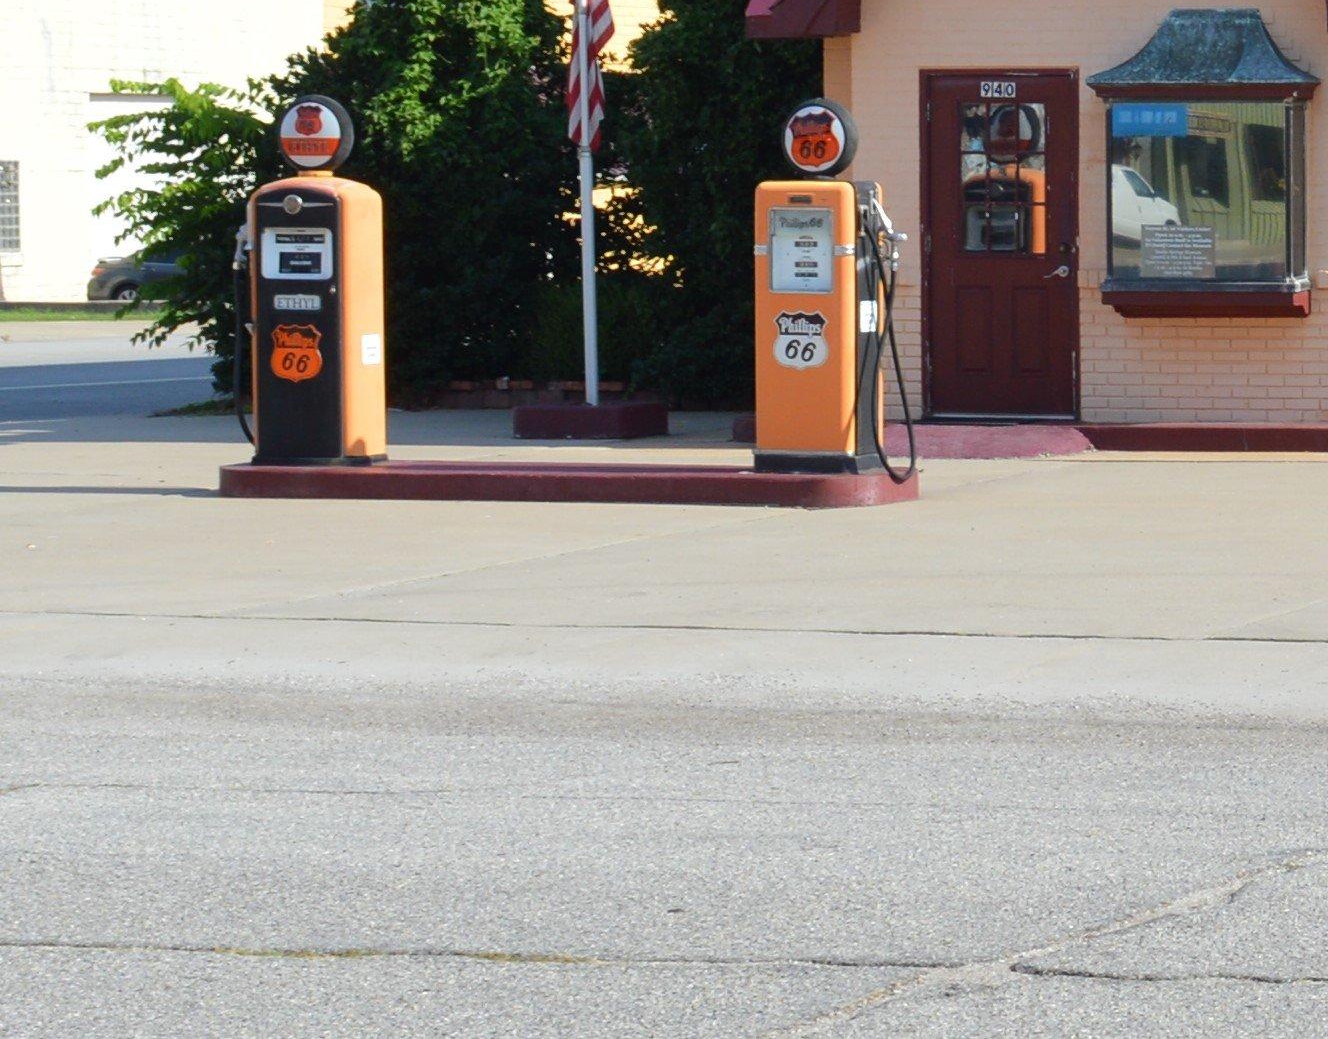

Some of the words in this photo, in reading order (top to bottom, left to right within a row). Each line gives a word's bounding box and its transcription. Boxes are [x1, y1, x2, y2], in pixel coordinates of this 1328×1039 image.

[981, 82, 1015, 97] 940
[800, 141, 826, 158] 66
[276, 297, 319, 309] ETHYL
[778, 316, 822, 338] Phillips
[785, 339, 817, 362] 66
[282, 352, 311, 373] 66
